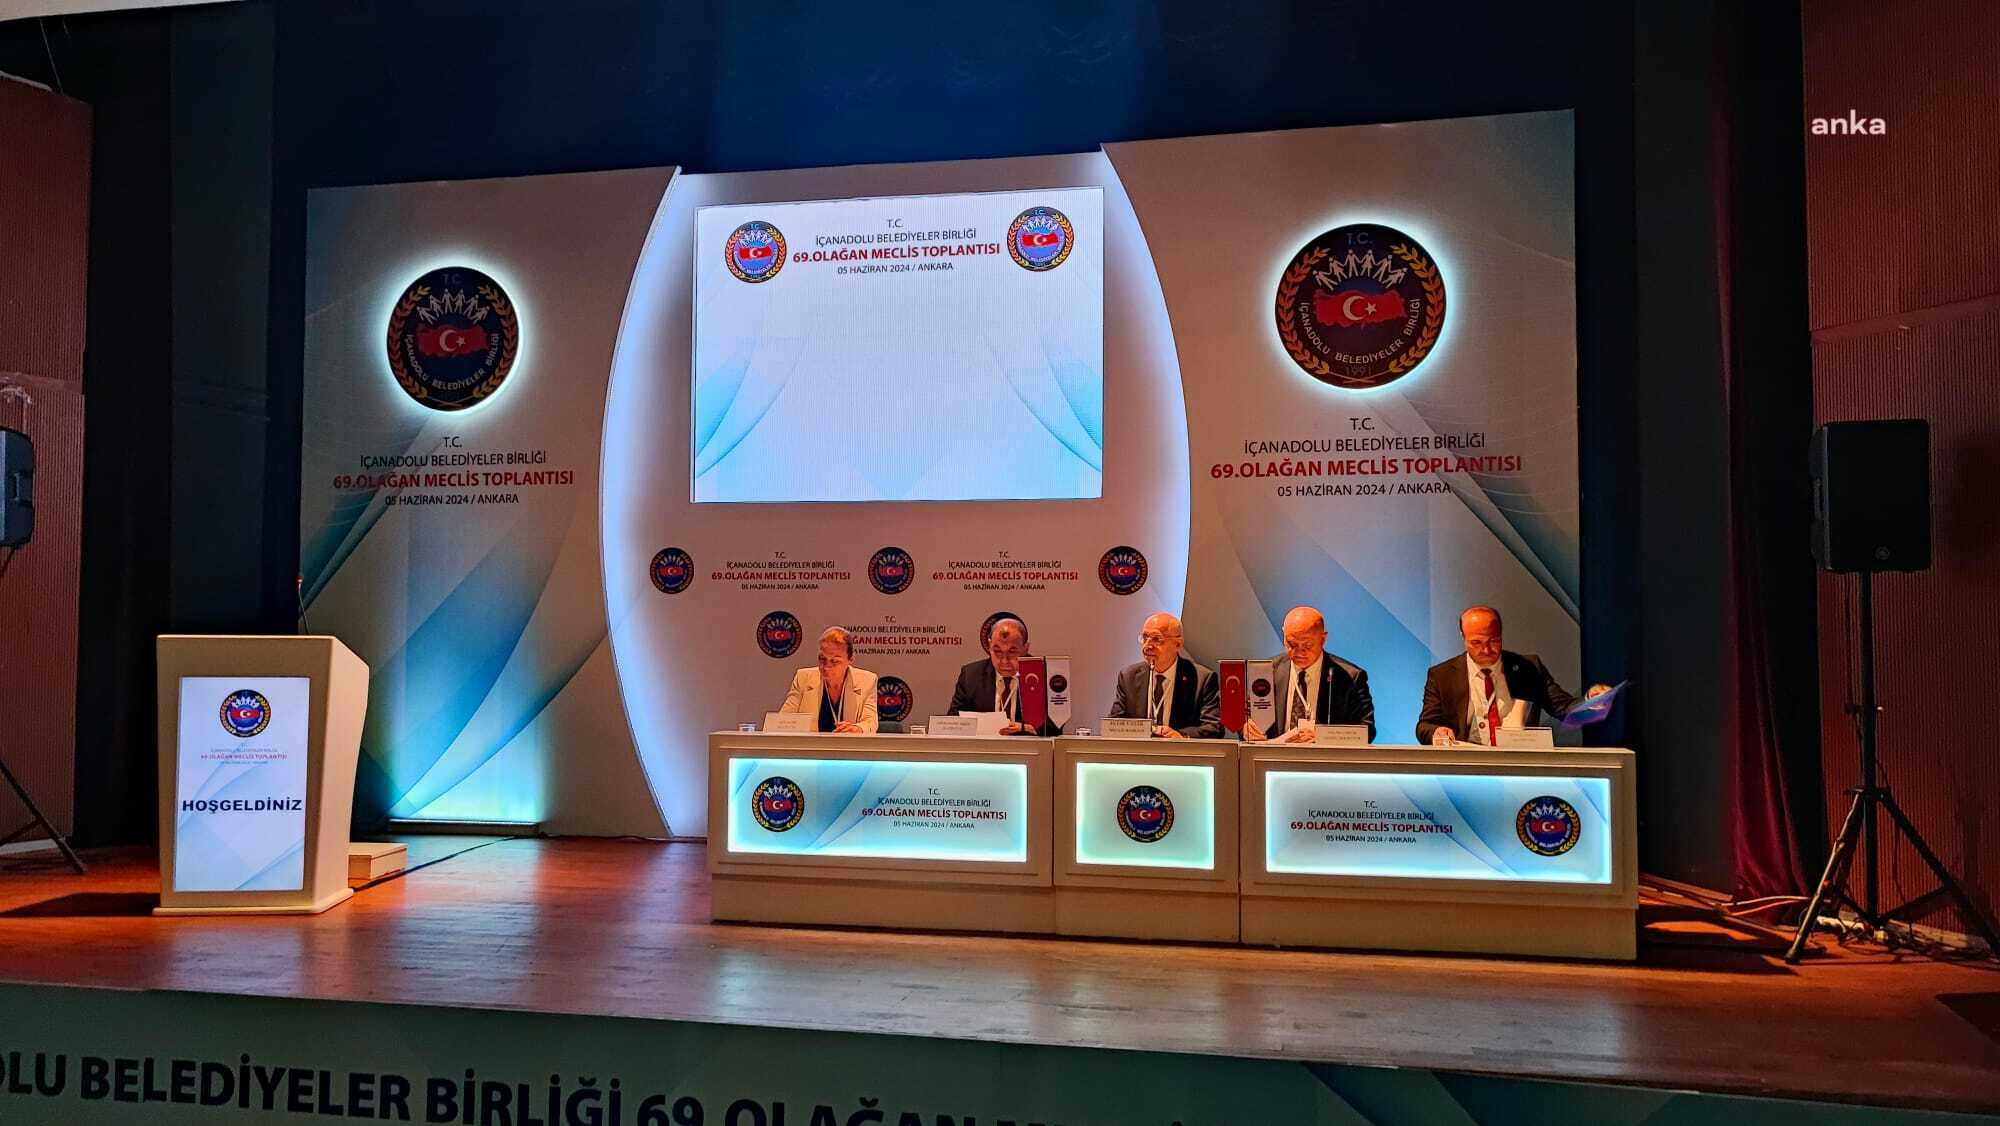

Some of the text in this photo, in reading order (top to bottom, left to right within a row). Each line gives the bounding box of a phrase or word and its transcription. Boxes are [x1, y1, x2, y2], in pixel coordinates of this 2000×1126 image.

[816, 228, 976, 248] İÇANADOLU BELEDİYELER BİRLİĞİ
[793, 248, 868, 263] 69.OLAĞAN
[872, 245, 918, 259] MECLİS
[921, 243, 1000, 257] TOPLANTISI
[838, 266, 847, 274] 05
[850, 263, 887, 274] HAZİRAN
[890, 264, 909, 272] 2024
[918, 262, 953, 271] ANKARA
[1350, 418, 1375, 430] T.C.
[443, 437, 462, 448] T.C.
[1245, 432, 1485, 457] İÇANADOLU BELEDİYELER BİRLİĞİ
[360, 451, 545, 469] İÇANADOLU BELEDİYELER BİRLİĞİ
[1211, 456, 1520, 479] 69.OLAĞAN MECLİS TOPLANTISI
[334, 470, 573, 489] 69.OLAĞAN MECLİS TOPLANTISI
[1278, 486, 1292, 496] 05
[1296, 483, 1351, 496] HAZİRAN
[1355, 485, 1385, 496] 2024
[1398, 483, 1451, 494] ANKARA
[385, 496, 397, 505] 05
[400, 494, 443, 505] HAZİRAN
[446, 495, 469, 505] 2024
[478, 494, 519, 504] ANKARA
[712, 571, 850, 580] 69.OLAĞAN MECLİS TOPLANTISI
[933, 571, 1078, 580] 69.OLAĞAN MECLİS TOPLANTISI
[875, 636, 906, 644] MECLİS
[908, 637, 962, 645] TOPLANTISI
[182, 796, 302, 814] HOŞGELDİNİZ
[879, 798, 919, 806] İÇANADOLU
[922, 798, 965, 806] BELEDİYELER
[862, 807, 1007, 820] 69.OLAĞAN MECLİS TOPLANTISI
[1309, 810, 1434, 820] İÇANADOLU BELEDİYELER BİRLİĞİ
[1291, 821, 1452, 833] 69.OLAĞAN MECLİS TOPLANTISI
[0, 1050, 67, 1097] LU
[80, 1053, 412, 1122] BELEDİYELER
[425, 1068, 622, 1126] BİRLİĞİ
